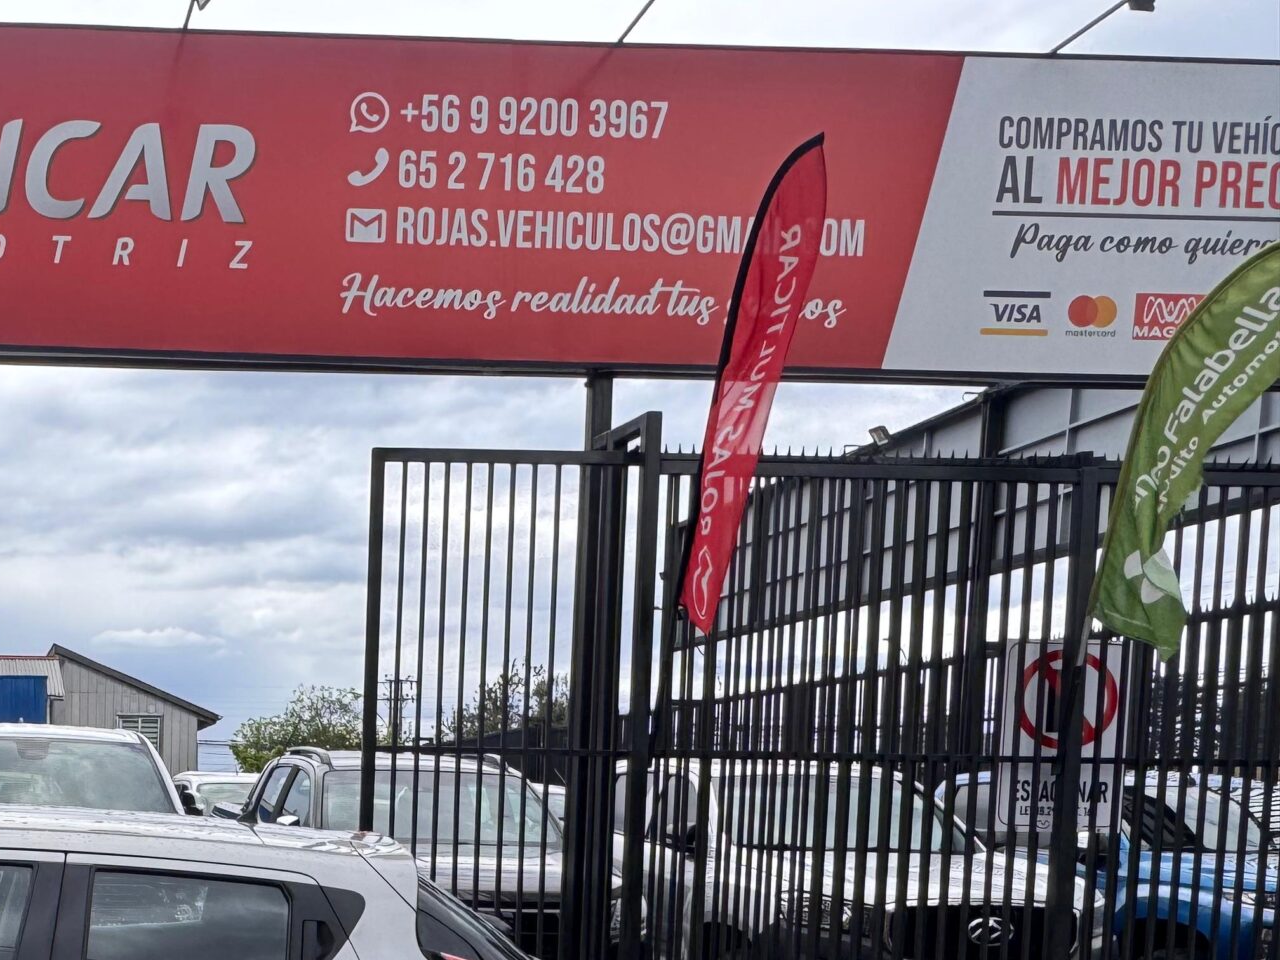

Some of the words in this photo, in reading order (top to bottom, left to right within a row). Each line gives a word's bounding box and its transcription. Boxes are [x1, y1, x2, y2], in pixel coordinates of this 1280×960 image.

[400, 94, 460, 134] +56
[470, 95, 489, 134] 9
[499, 97, 579, 137] 9200
[589, 99, 669, 139] 3967
[998, 115, 1164, 152] COMPRAMOS
[1171, 120, 1204, 153] TU
[398, 149, 437, 189] 65
[447, 151, 467, 190] 2
[477, 152, 536, 192] 716
[544, 155, 605, 194] 428
[995, 155, 1043, 204] AL
[1056, 157, 1182, 207] MEJOR
[396, 207, 865, 257] ROJAS.VEHICULOS@GMOM
[1010, 223, 1095, 262] Paga
[1099, 235, 1179, 255] como
[339, 272, 507, 320] Hacemos
[510, 276, 664, 317] realidad
[663, 279, 720, 326] tus
[990, 303, 1042, 323] VISA
[1065, 329, 1116, 338] mastercard
